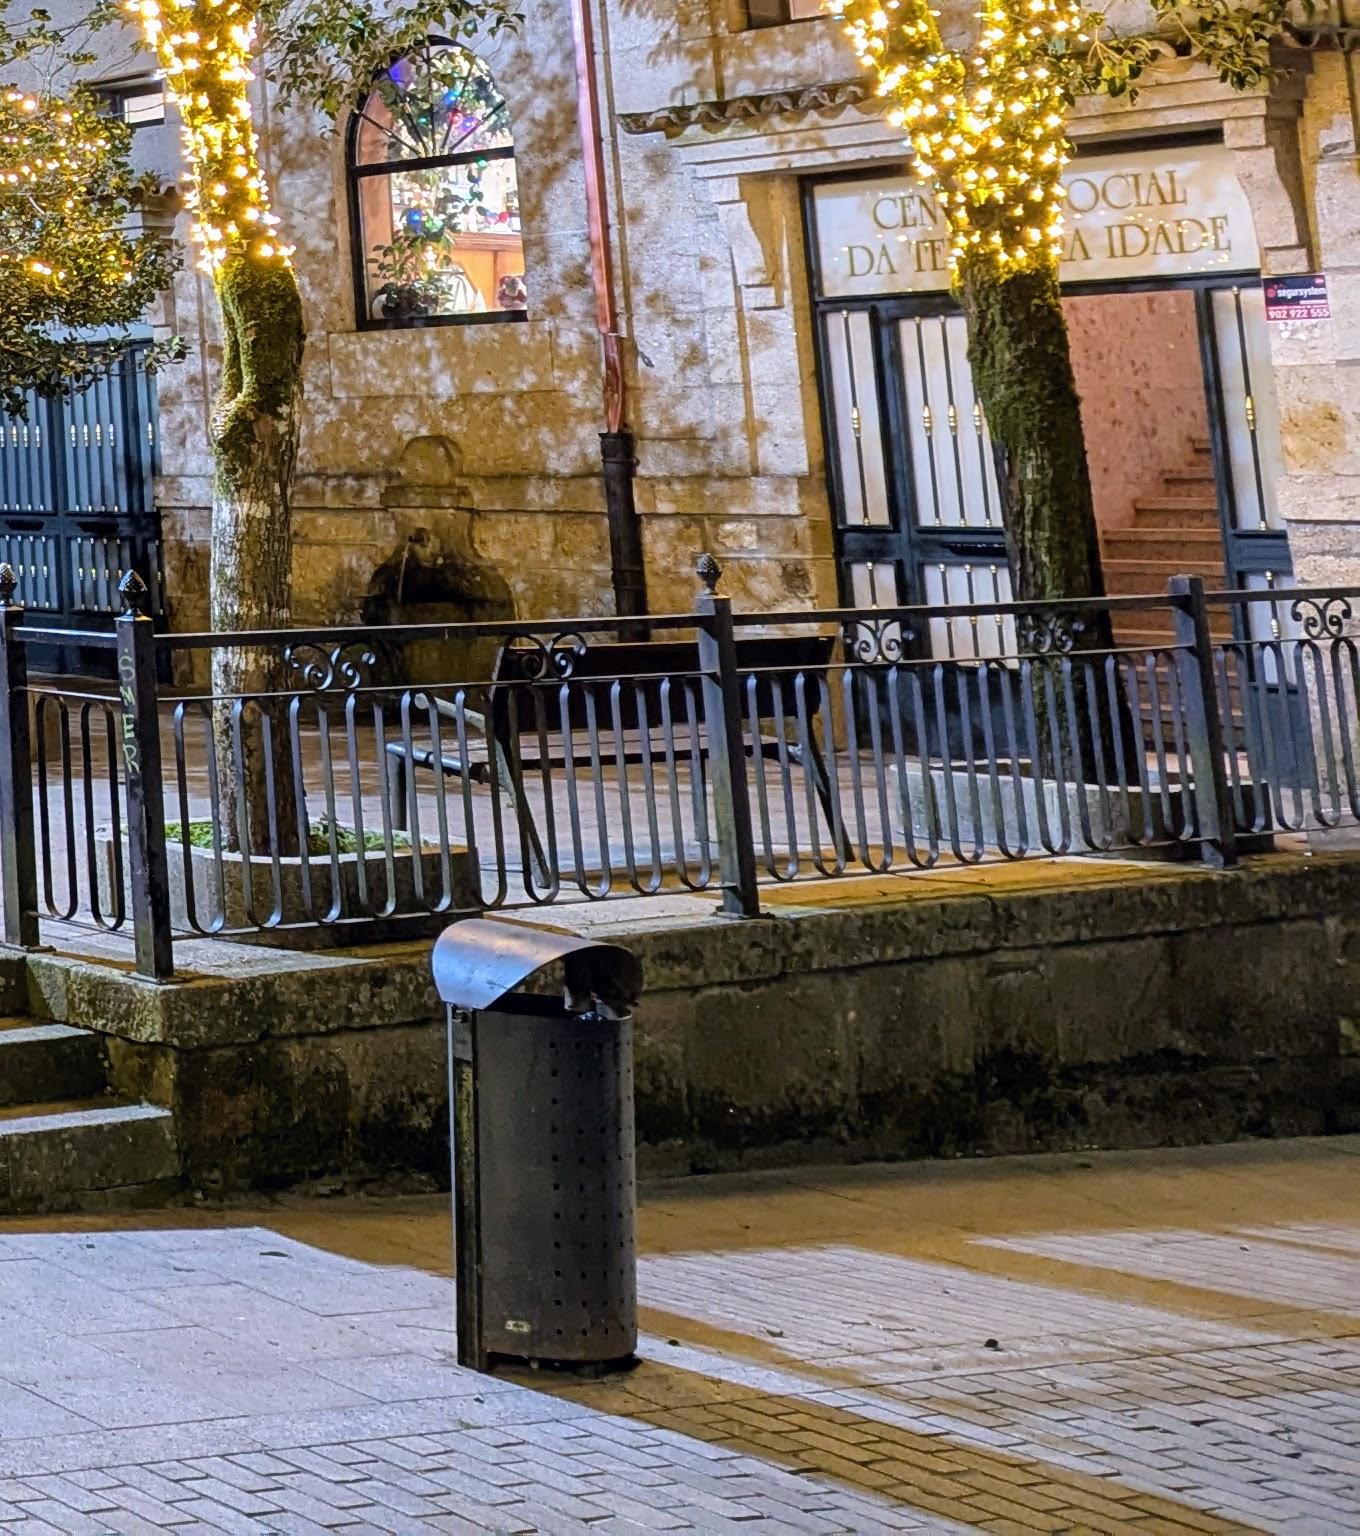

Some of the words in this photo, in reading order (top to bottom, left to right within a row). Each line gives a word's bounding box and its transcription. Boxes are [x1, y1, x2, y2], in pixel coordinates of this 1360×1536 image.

[1066, 169, 1187, 213] OCIAL
[847, 243, 898, 278] DA
[1104, 214, 1232, 259] IDADE
